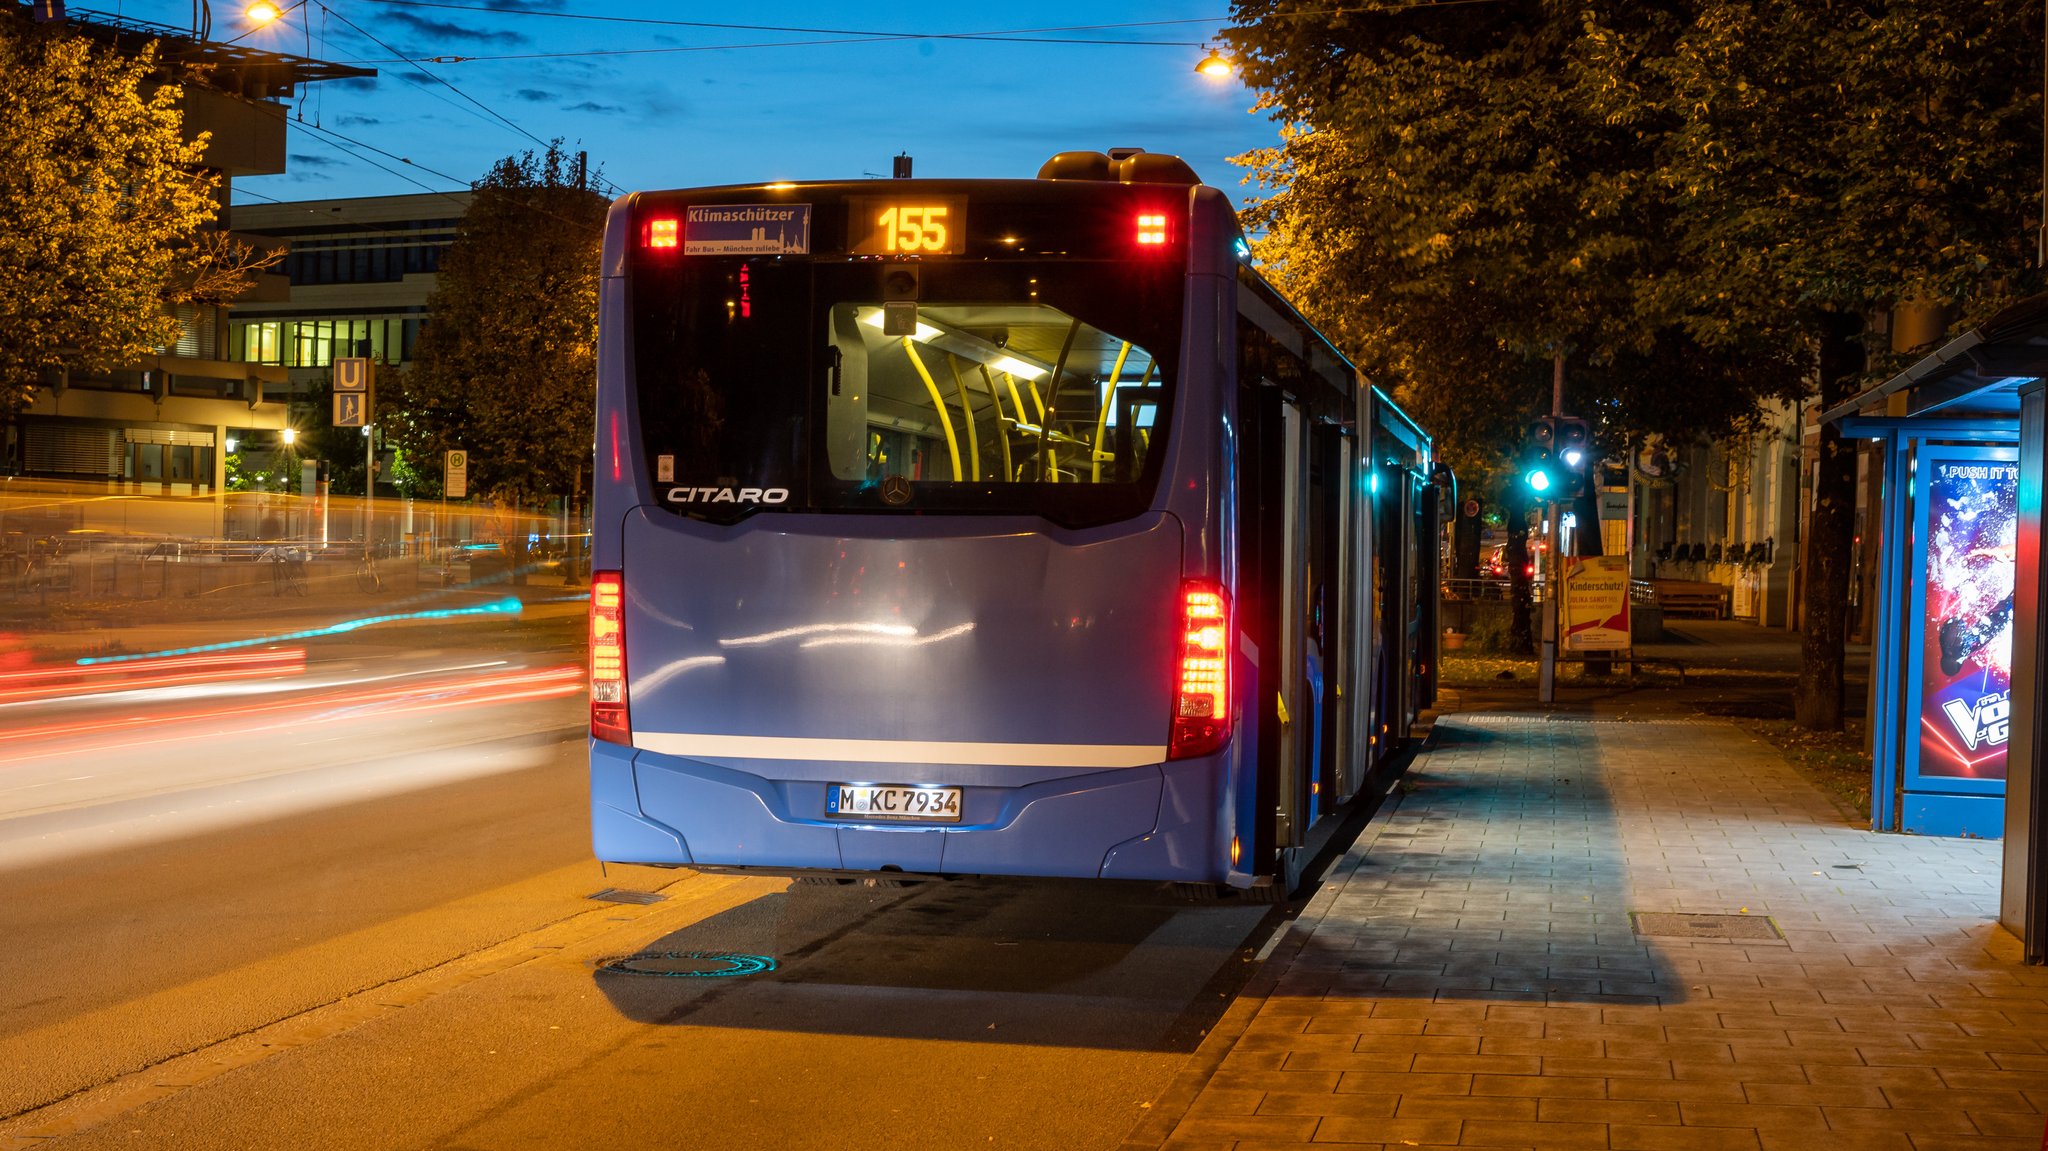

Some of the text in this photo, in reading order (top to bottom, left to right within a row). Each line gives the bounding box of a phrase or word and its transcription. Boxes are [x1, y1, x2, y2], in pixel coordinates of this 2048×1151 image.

[688, 208, 794, 222] Klimaschützer
[879, 207, 947, 250] 155
[723, 244, 754, 252] München
[340, 362, 360, 388] U
[1949, 466, 1988, 479] PUSH
[1990, 466, 2005, 480] IT
[667, 487, 789, 504] CITARO
[1569, 581, 1624, 592] Kinderschutz!
[1976, 727, 1988, 738] of
[840, 789, 957, 813] M KC 7934
